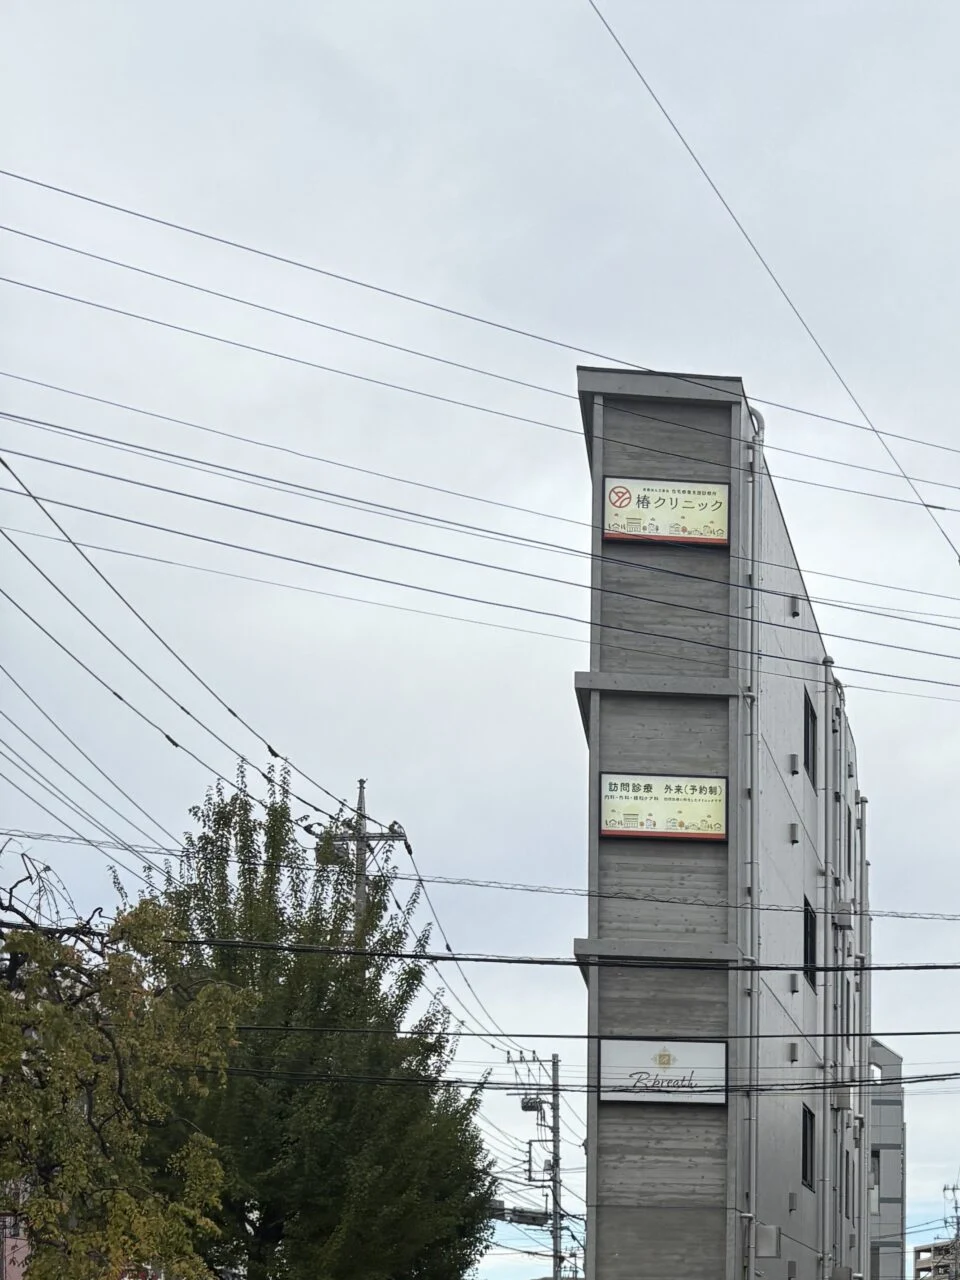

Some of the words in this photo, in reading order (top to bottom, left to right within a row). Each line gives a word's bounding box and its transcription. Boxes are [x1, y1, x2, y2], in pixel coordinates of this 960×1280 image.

[636, 494, 723, 511] 椿クリニック
[608, 782, 653, 793] 訪問診療
